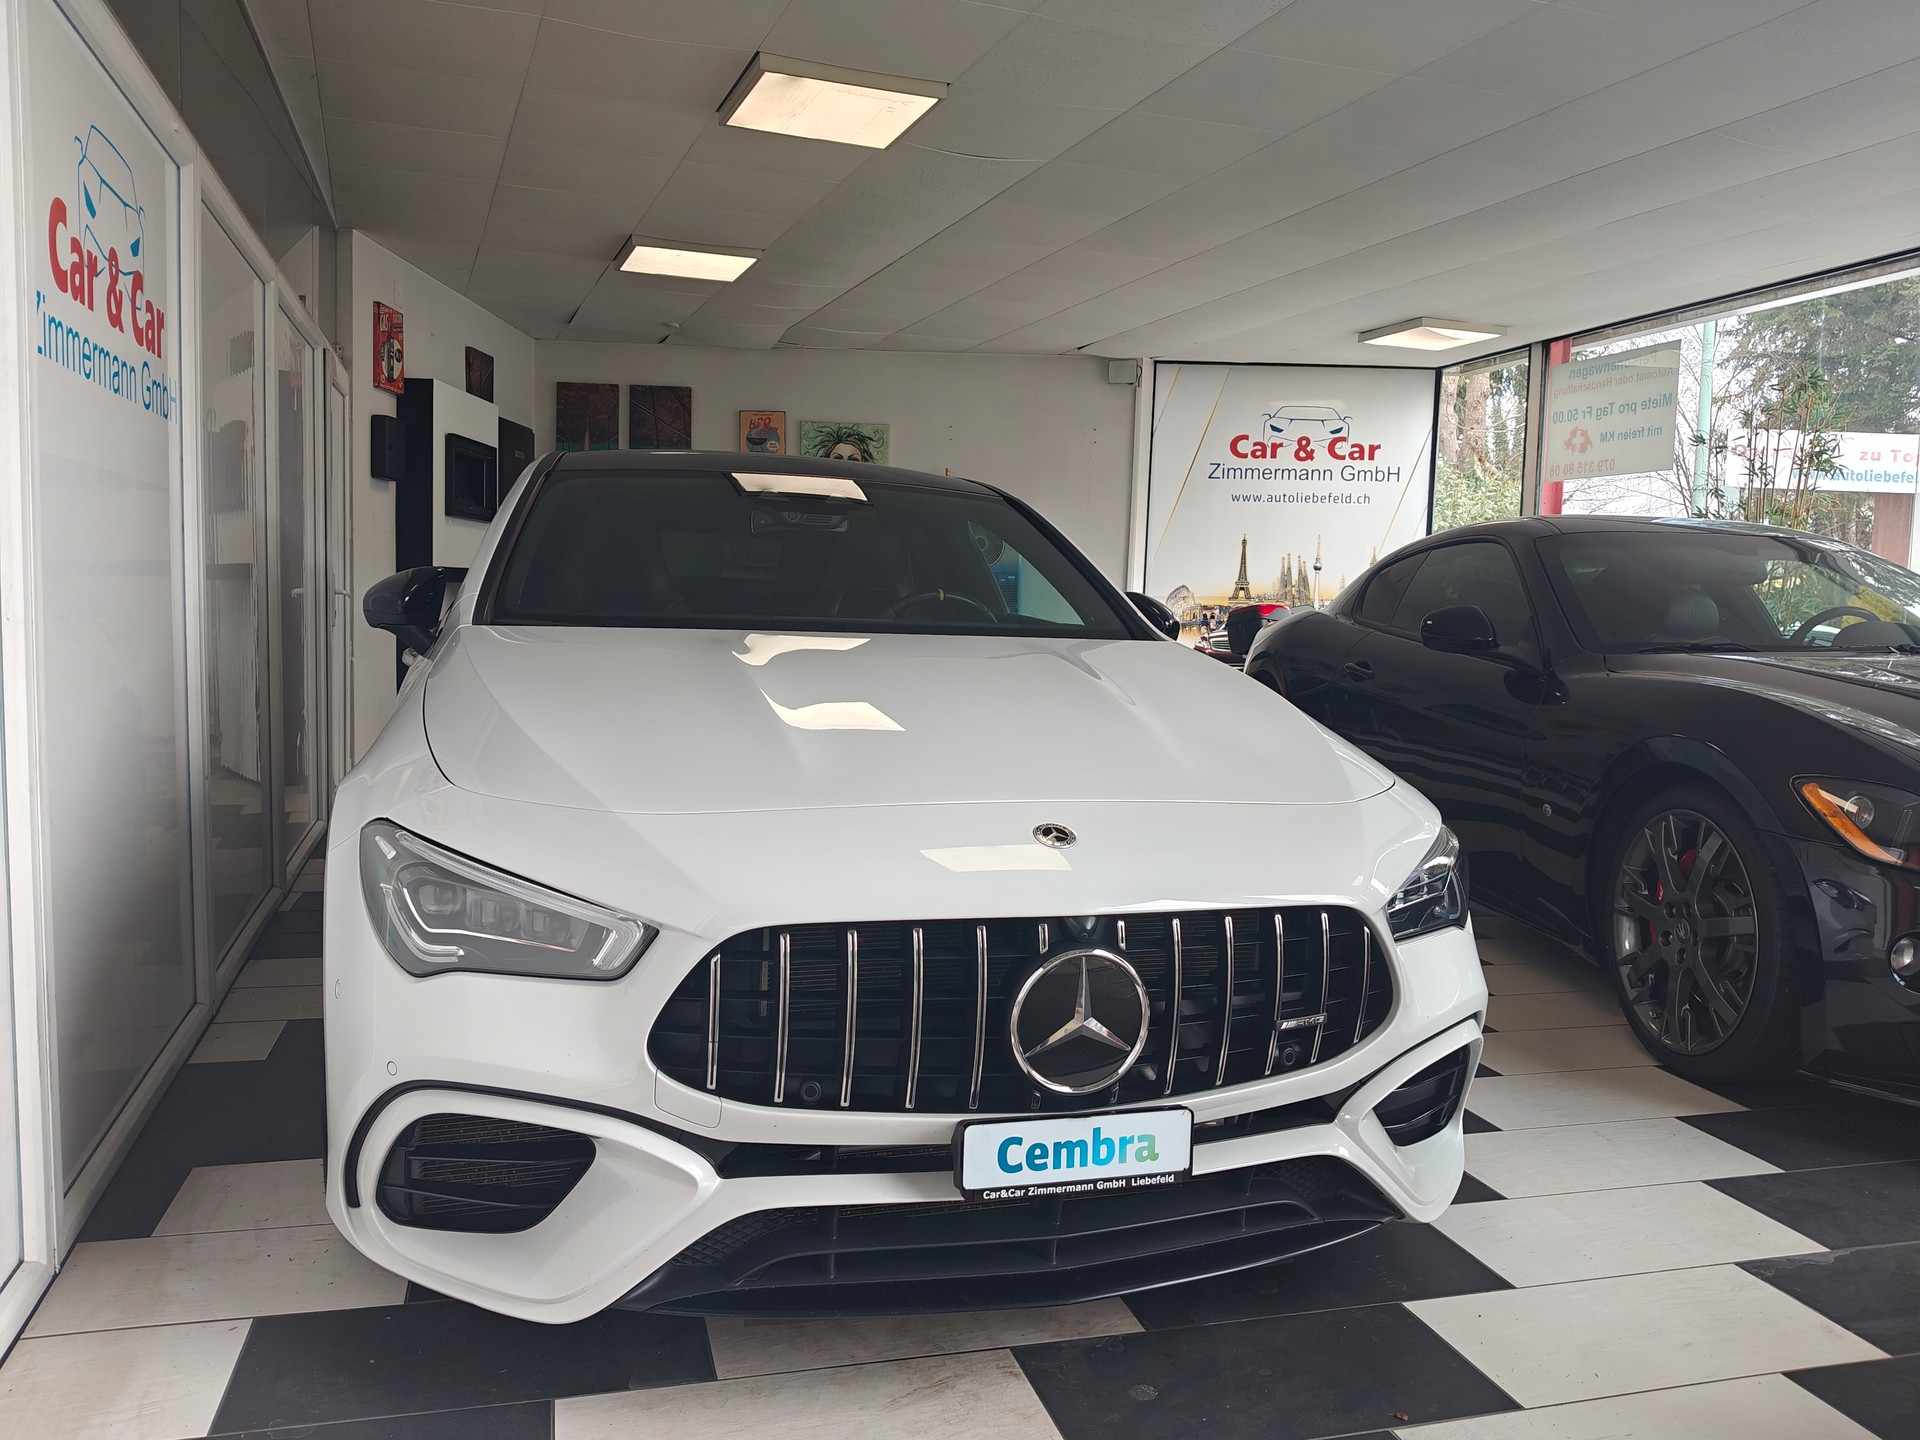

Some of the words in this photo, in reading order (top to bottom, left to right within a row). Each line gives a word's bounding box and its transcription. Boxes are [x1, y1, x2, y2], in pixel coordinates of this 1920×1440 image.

[48, 196, 98, 313] Car
[106, 246, 125, 334] &
[130, 269, 165, 360] Car
[36, 290, 138, 404] immermann
[141, 360, 178, 425] GmbH
[1229, 434, 1284, 460] Car
[1293, 435, 1316, 462] &
[1327, 436, 1382, 461] Car
[1859, 451, 1882, 462] zu
[1207, 462, 1334, 482] Zimmermann
[1340, 465, 1401, 483] GmbH
[1231, 491, 1371, 505] www.autoliebefeld.ch
[997, 1126, 1160, 1174] Cembra
[982, 1187, 1026, 1200] Car&Car
[1027, 1181, 1094, 1197] Zimmermann
[1096, 1178, 1126, 1191] GmbH
[1131, 1173, 1175, 1187] Liebefeld
